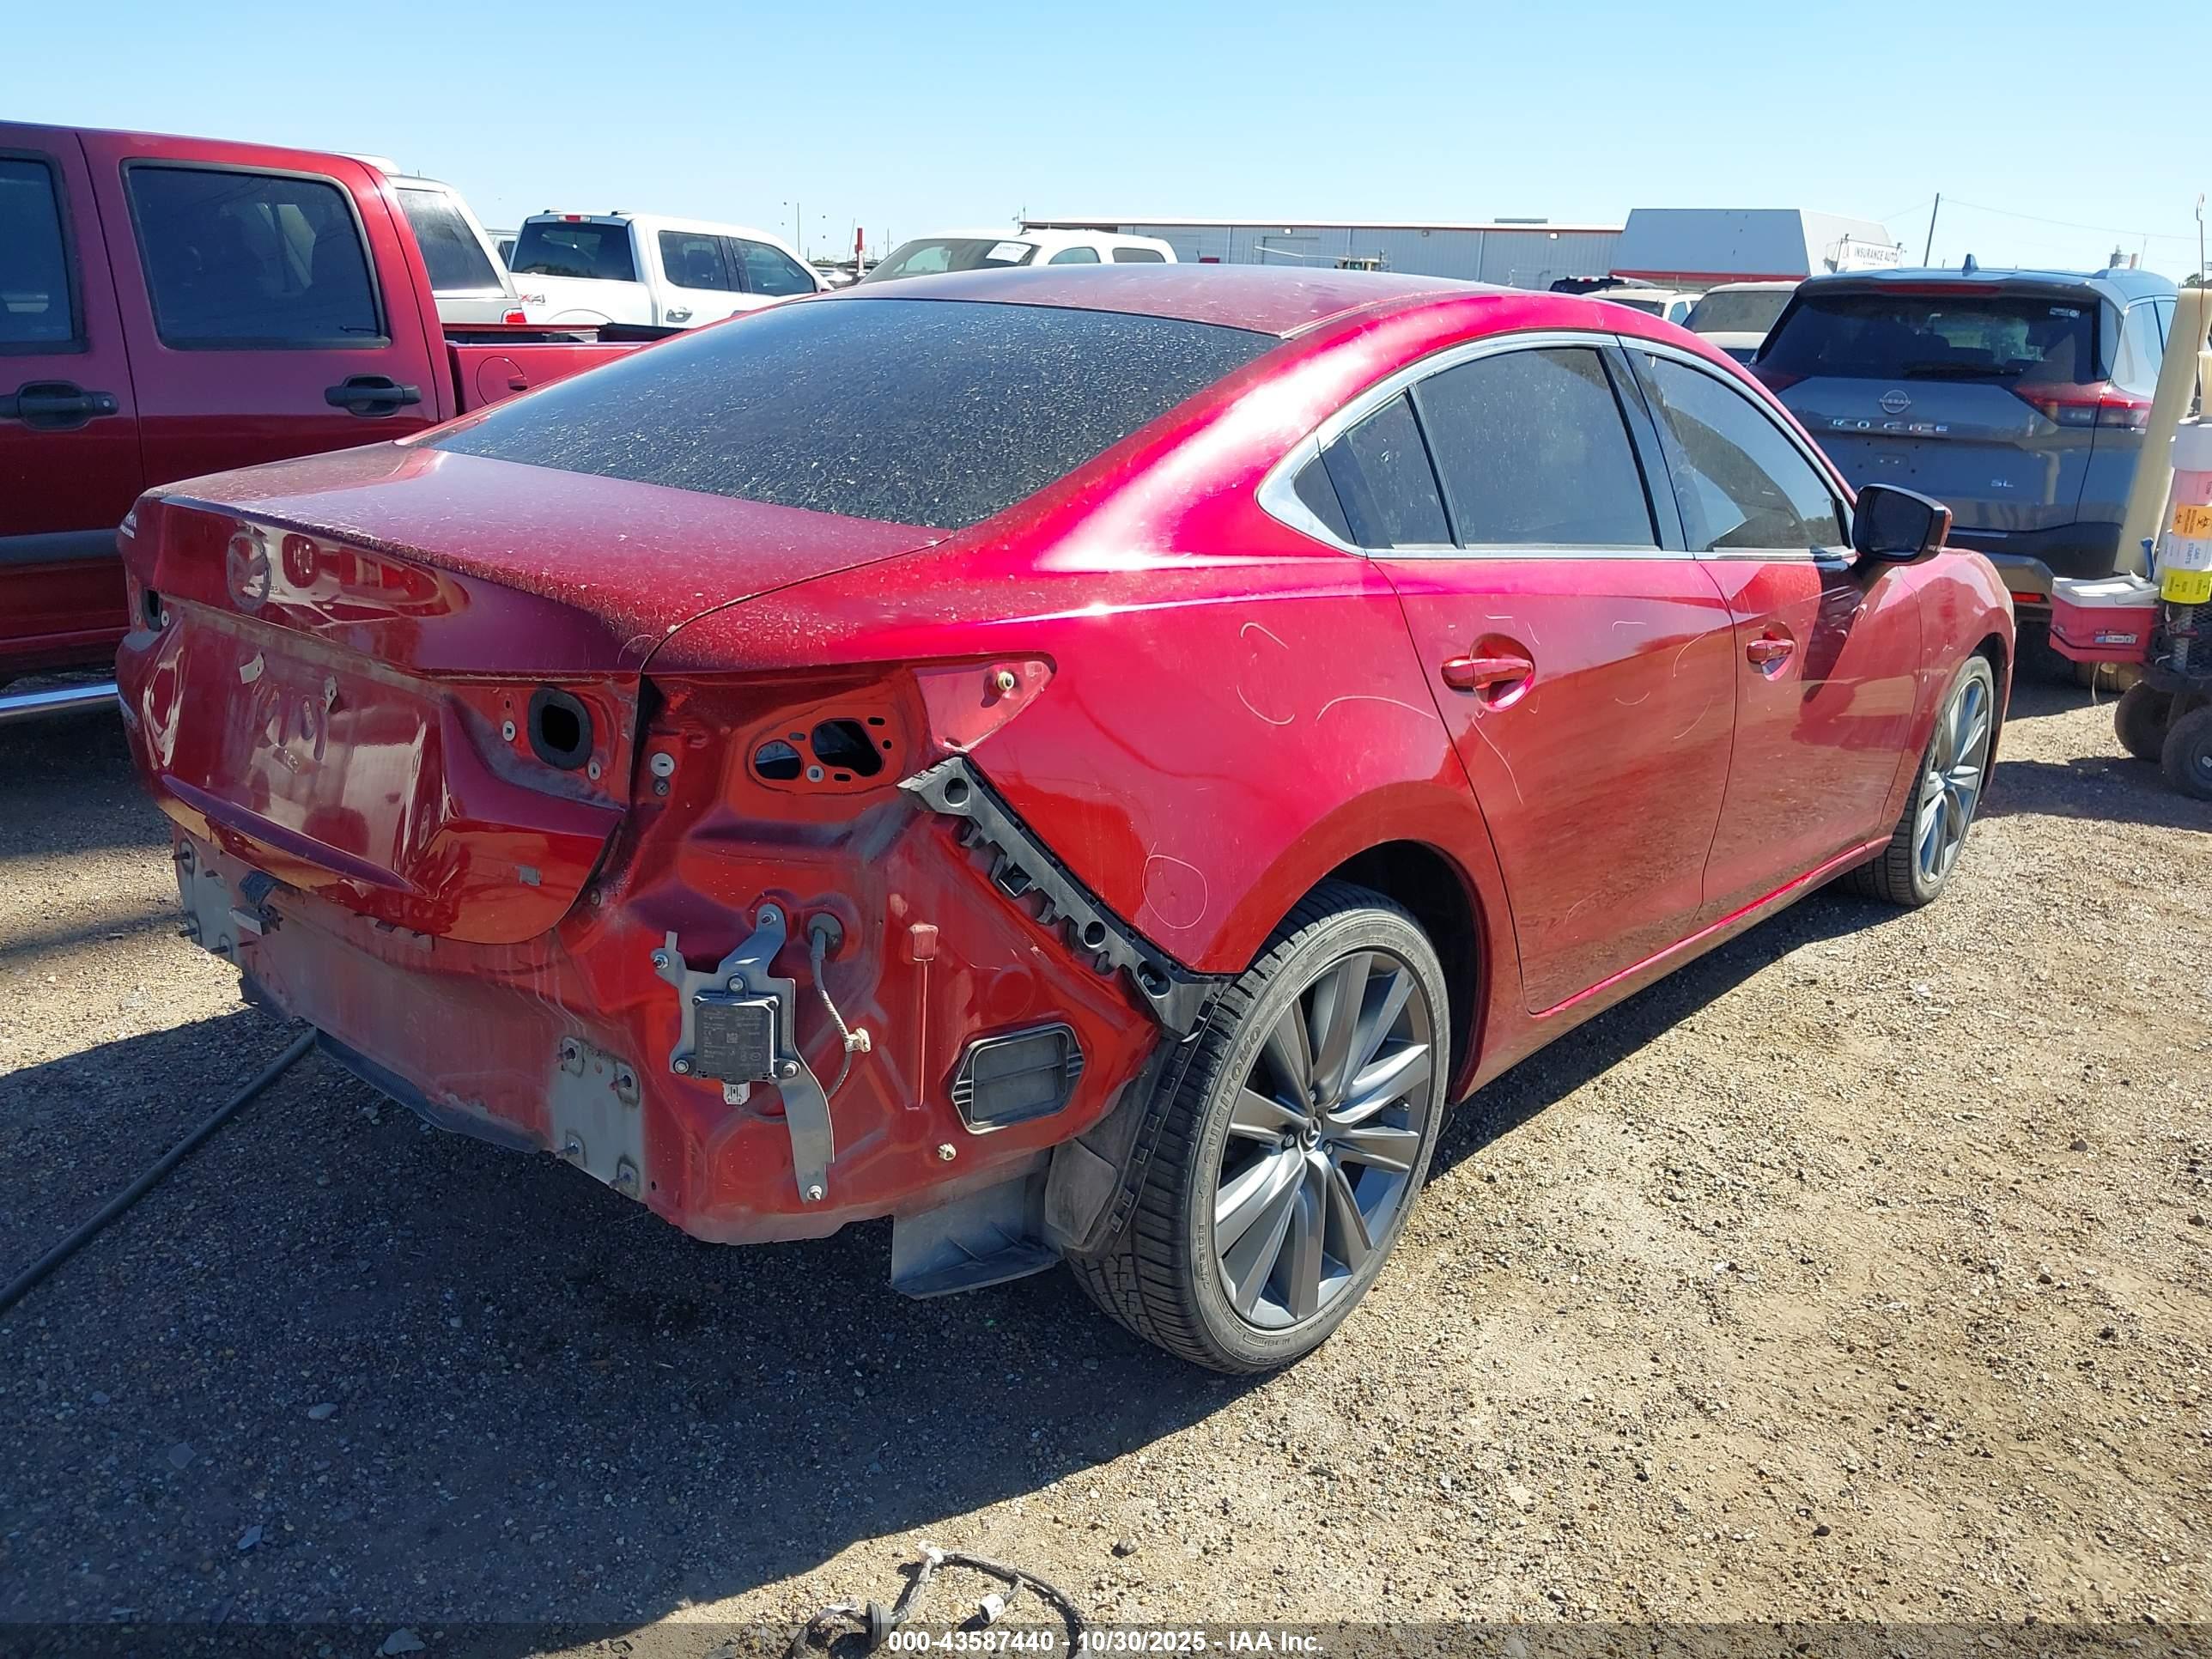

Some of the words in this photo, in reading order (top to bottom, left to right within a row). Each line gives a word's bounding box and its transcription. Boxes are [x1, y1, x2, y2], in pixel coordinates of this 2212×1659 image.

[1855, 246, 1884, 261] INSURANCE
[1879, 398, 1911, 406] NISSAN
[1991, 478, 2014, 488] SL
[1204, 1025, 1261, 1164] SUMITOMO
